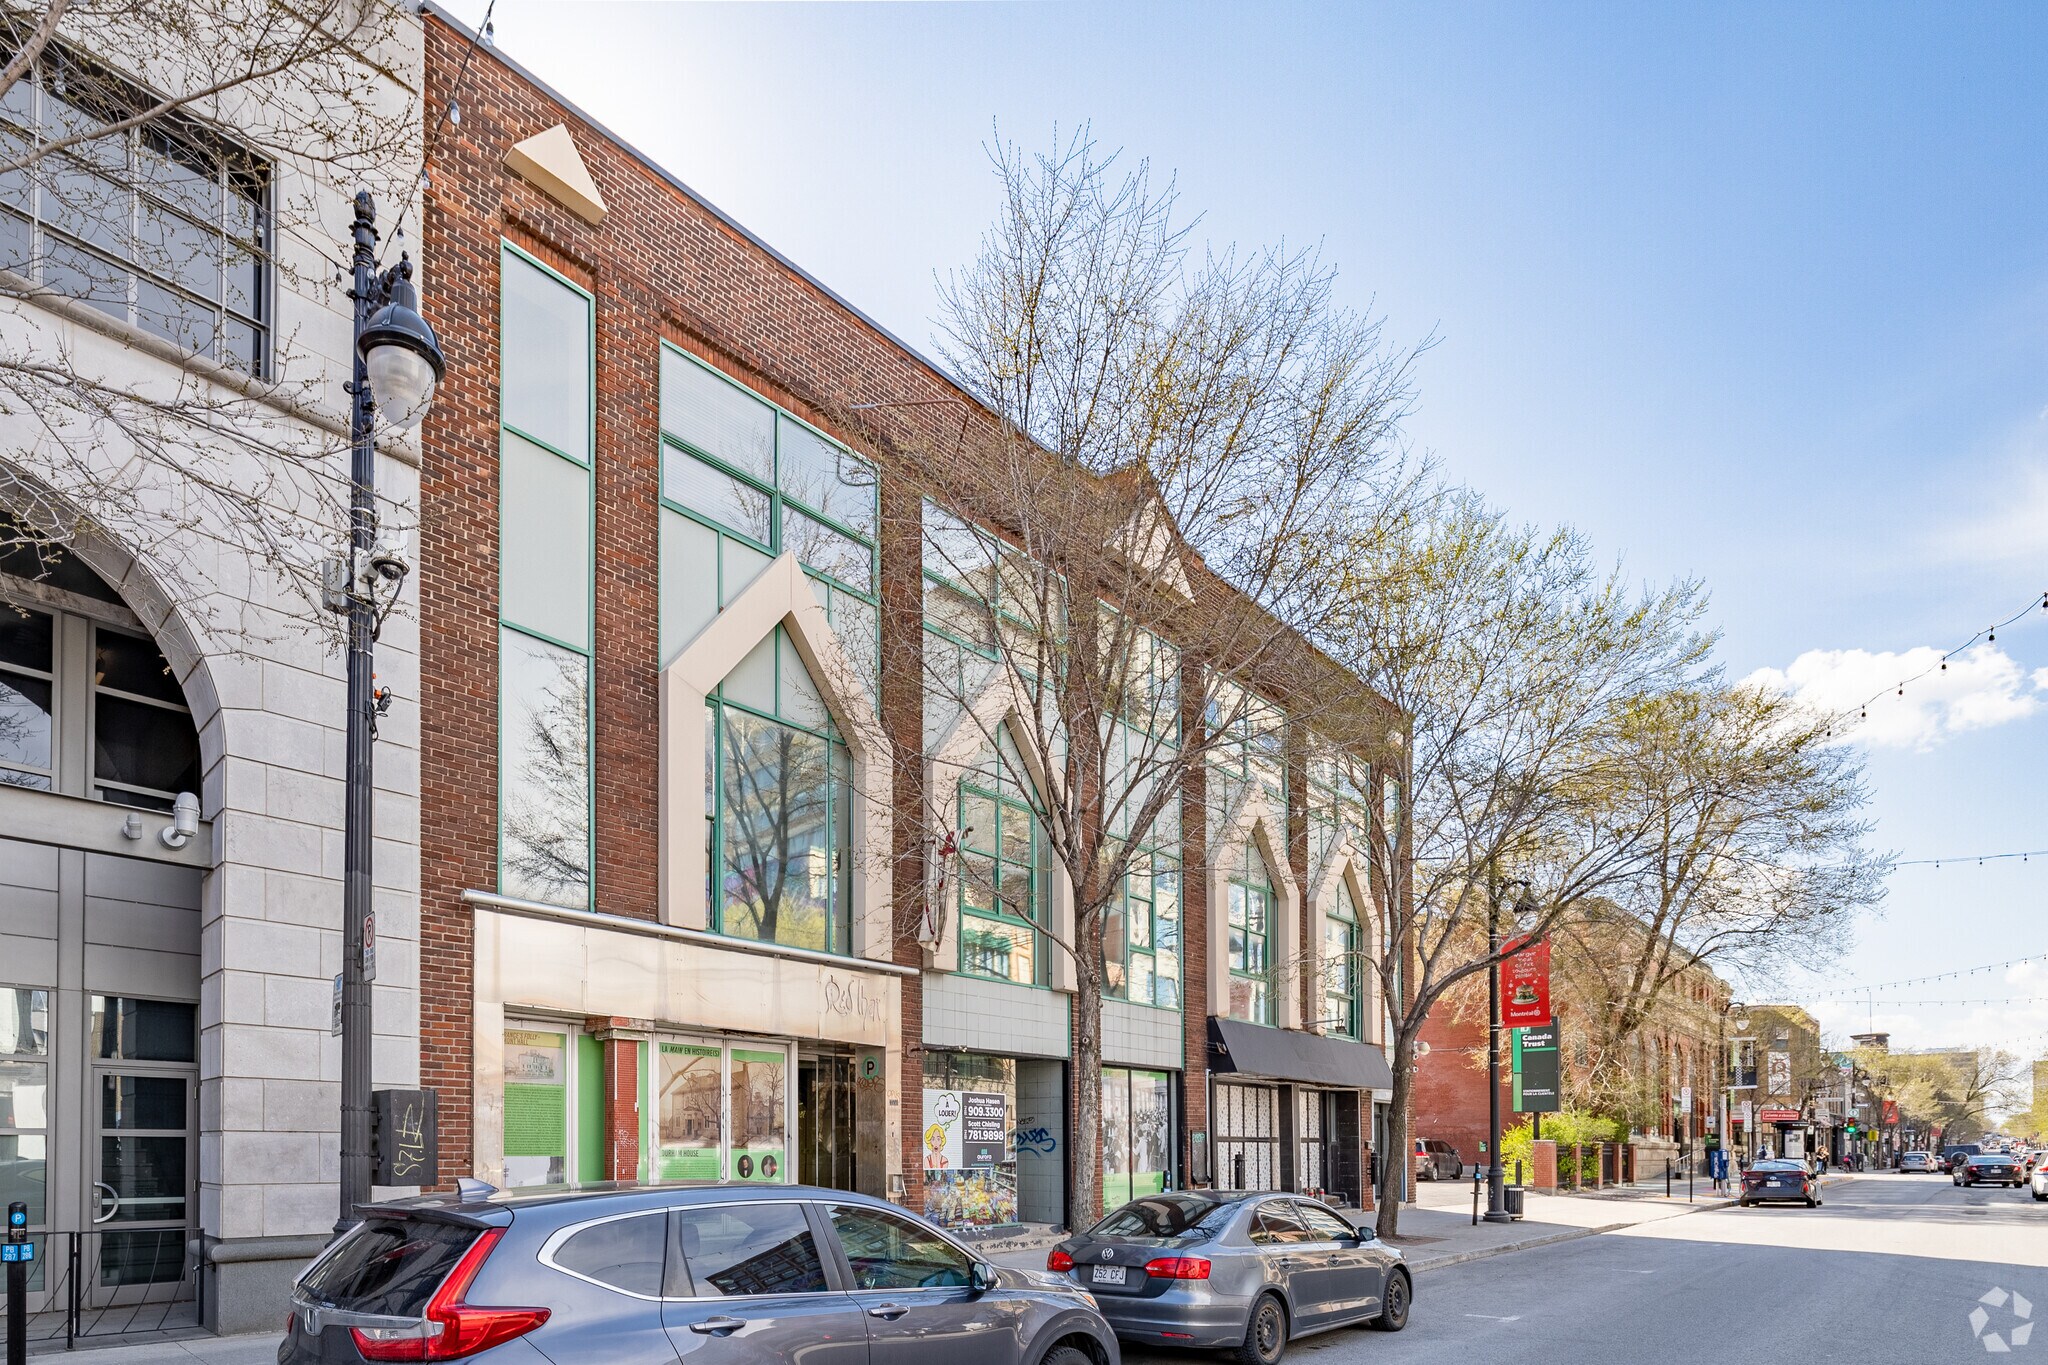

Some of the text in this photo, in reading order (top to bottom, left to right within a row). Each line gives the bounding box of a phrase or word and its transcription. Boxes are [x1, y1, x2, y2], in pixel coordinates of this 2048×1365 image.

[1522, 1033, 1552, 1041] Canada
[661, 1045, 668, 1053] LA
[670, 1046, 683, 1054] MAIN
[684, 1047, 690, 1055] EN
[867, 1061, 874, 1075] P
[968, 1106, 1004, 1117] 909.3300
[968, 1130, 1004, 1141] 781.9898
[682, 1149, 699, 1157] HOUSE
